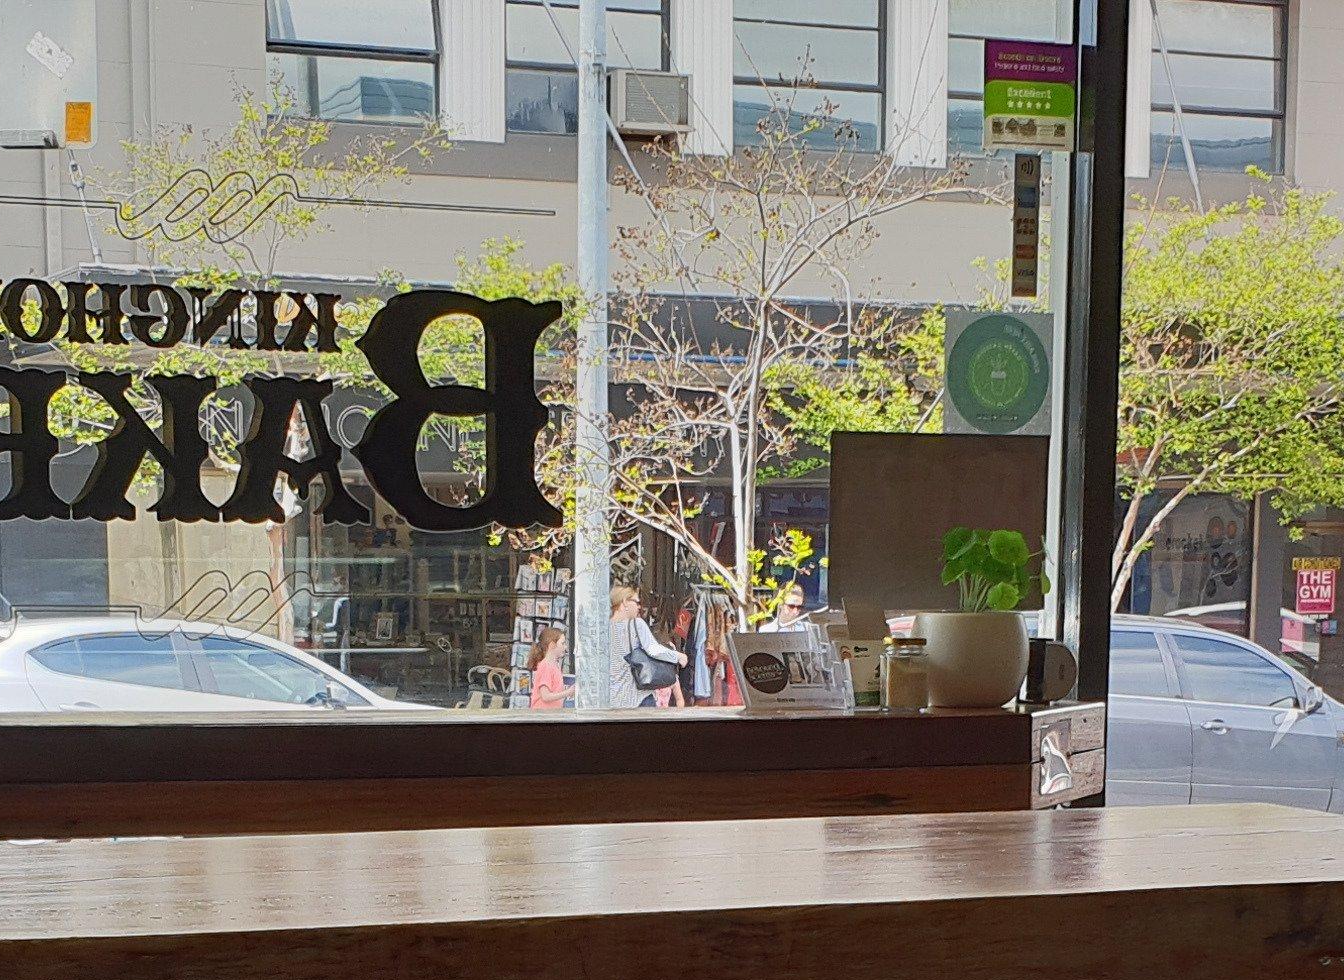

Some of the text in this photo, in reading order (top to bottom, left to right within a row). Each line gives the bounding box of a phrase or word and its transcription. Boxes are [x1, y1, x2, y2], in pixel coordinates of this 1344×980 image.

[1007, 87, 1052, 99] Excellent
[1299, 570, 1333, 584] THE
[1299, 585, 1332, 599] GYM
